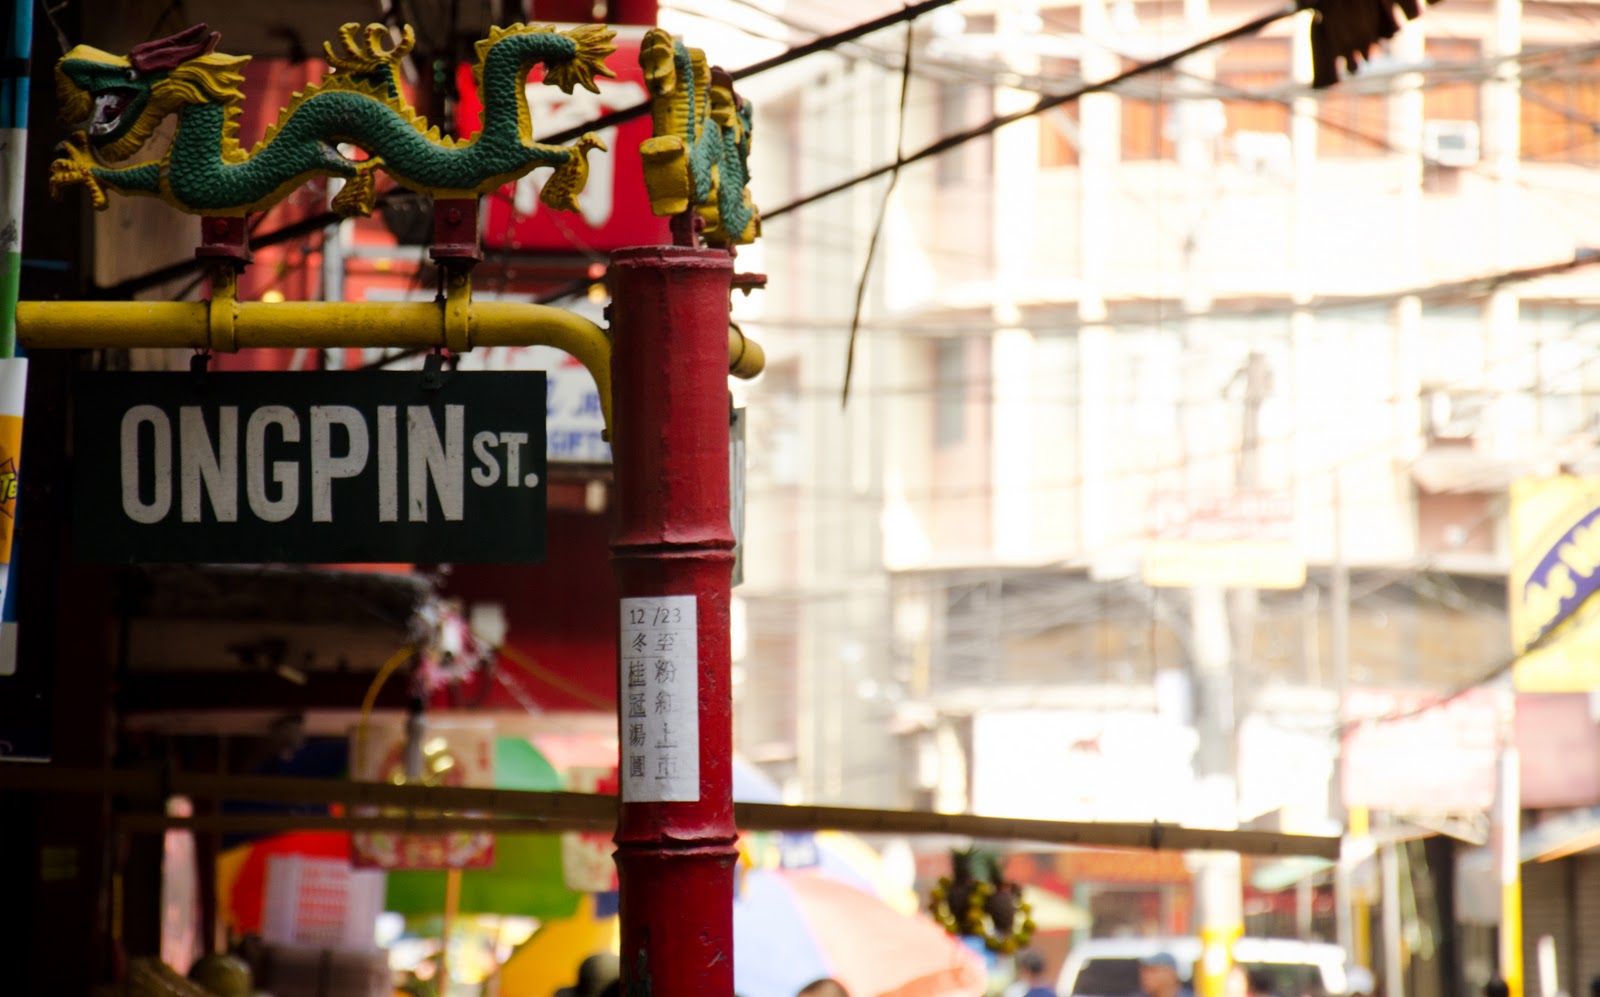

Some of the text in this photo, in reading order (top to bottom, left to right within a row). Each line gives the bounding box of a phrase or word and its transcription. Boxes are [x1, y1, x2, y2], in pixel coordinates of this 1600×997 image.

[120, 404, 539, 524] ONGPIN ST.
[629, 608, 645, 625] 12
